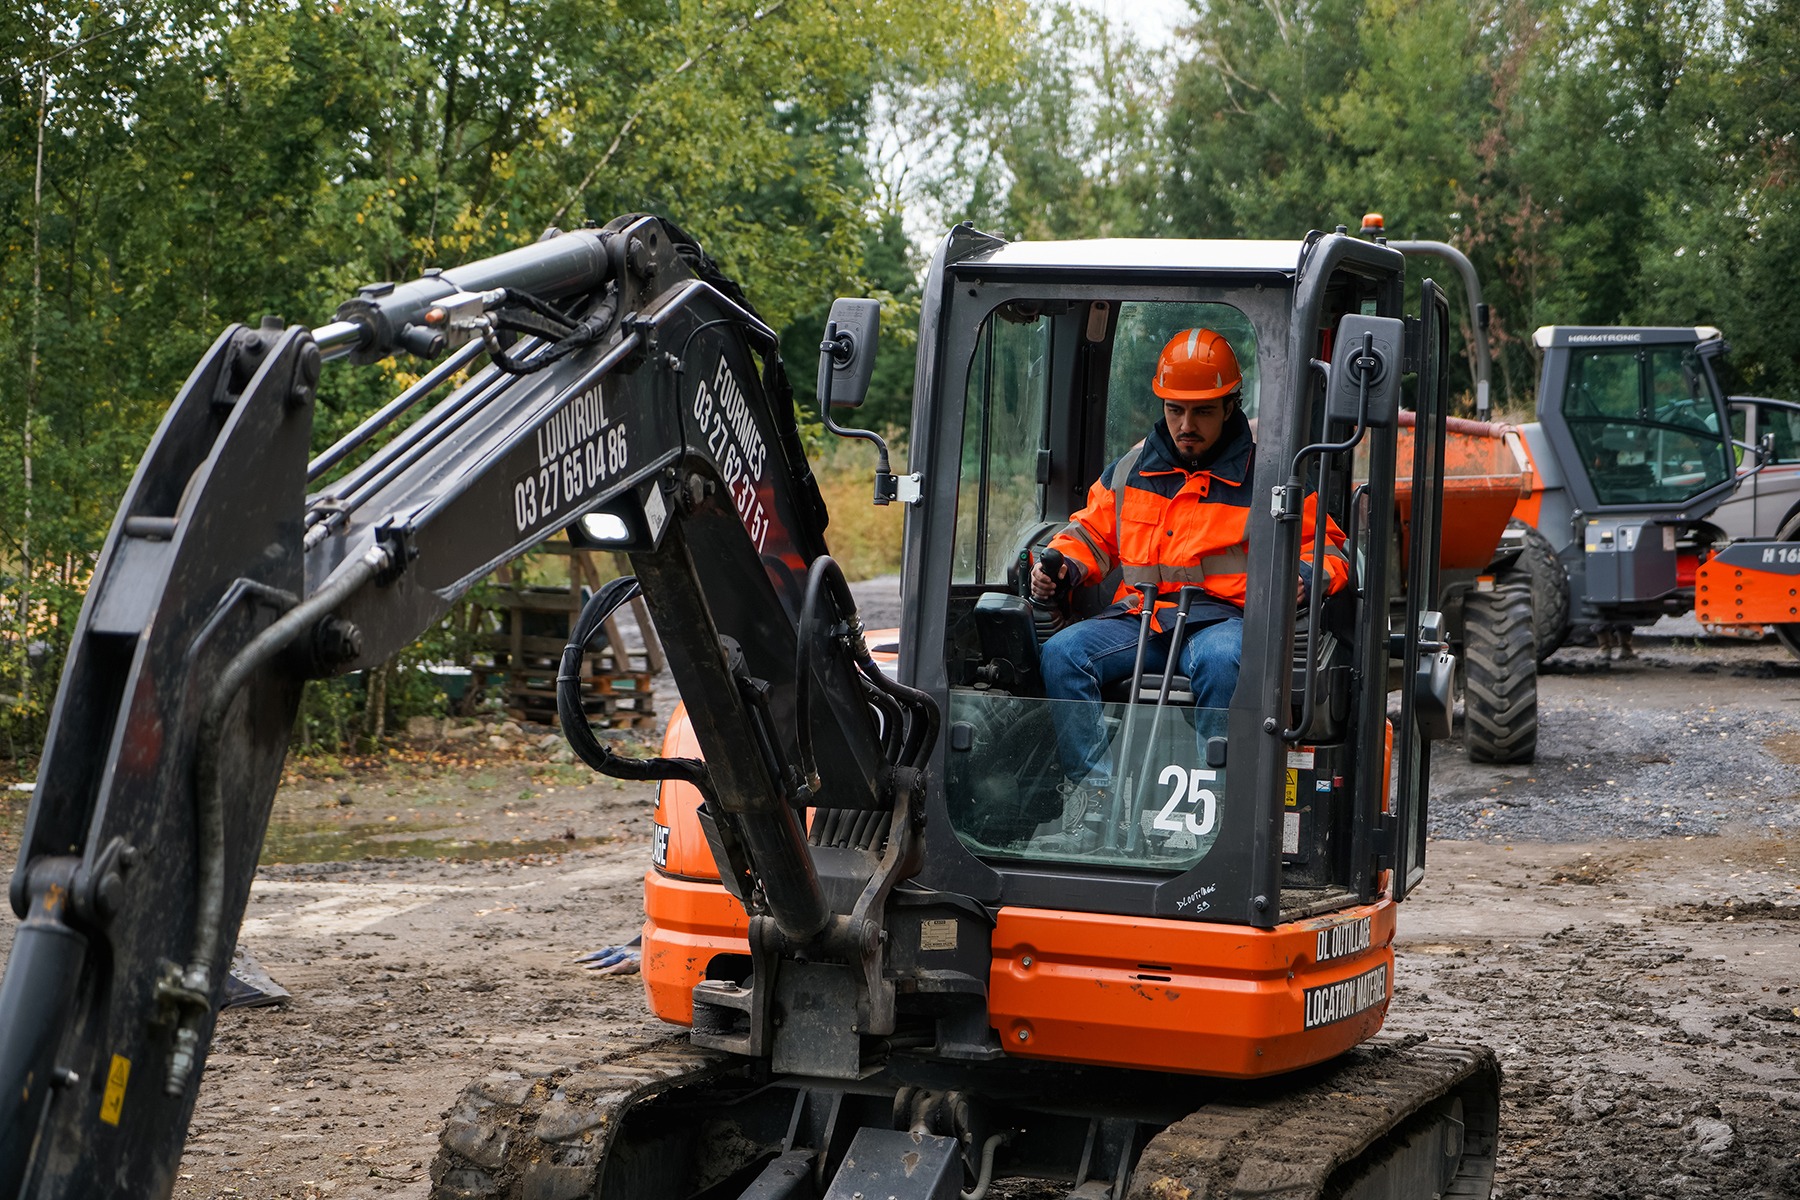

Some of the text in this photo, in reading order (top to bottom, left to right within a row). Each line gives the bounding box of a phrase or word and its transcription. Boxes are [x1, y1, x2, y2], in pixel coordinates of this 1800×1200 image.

[1568, 333, 1641, 343] HAMMTRONIC
[537, 383, 609, 468] LOUVROIL
[713, 354, 767, 482] FOURMIES
[514, 422, 628, 532] 03 27 65 04 86
[694, 380, 770, 554] 03 27 62 37 51
[1762, 548, 1775, 563] H
[1153, 764, 1217, 836] 25
[1317, 916, 1371, 961] DL OUTILLAGE
[1306, 980, 1356, 1027] LOCATION
